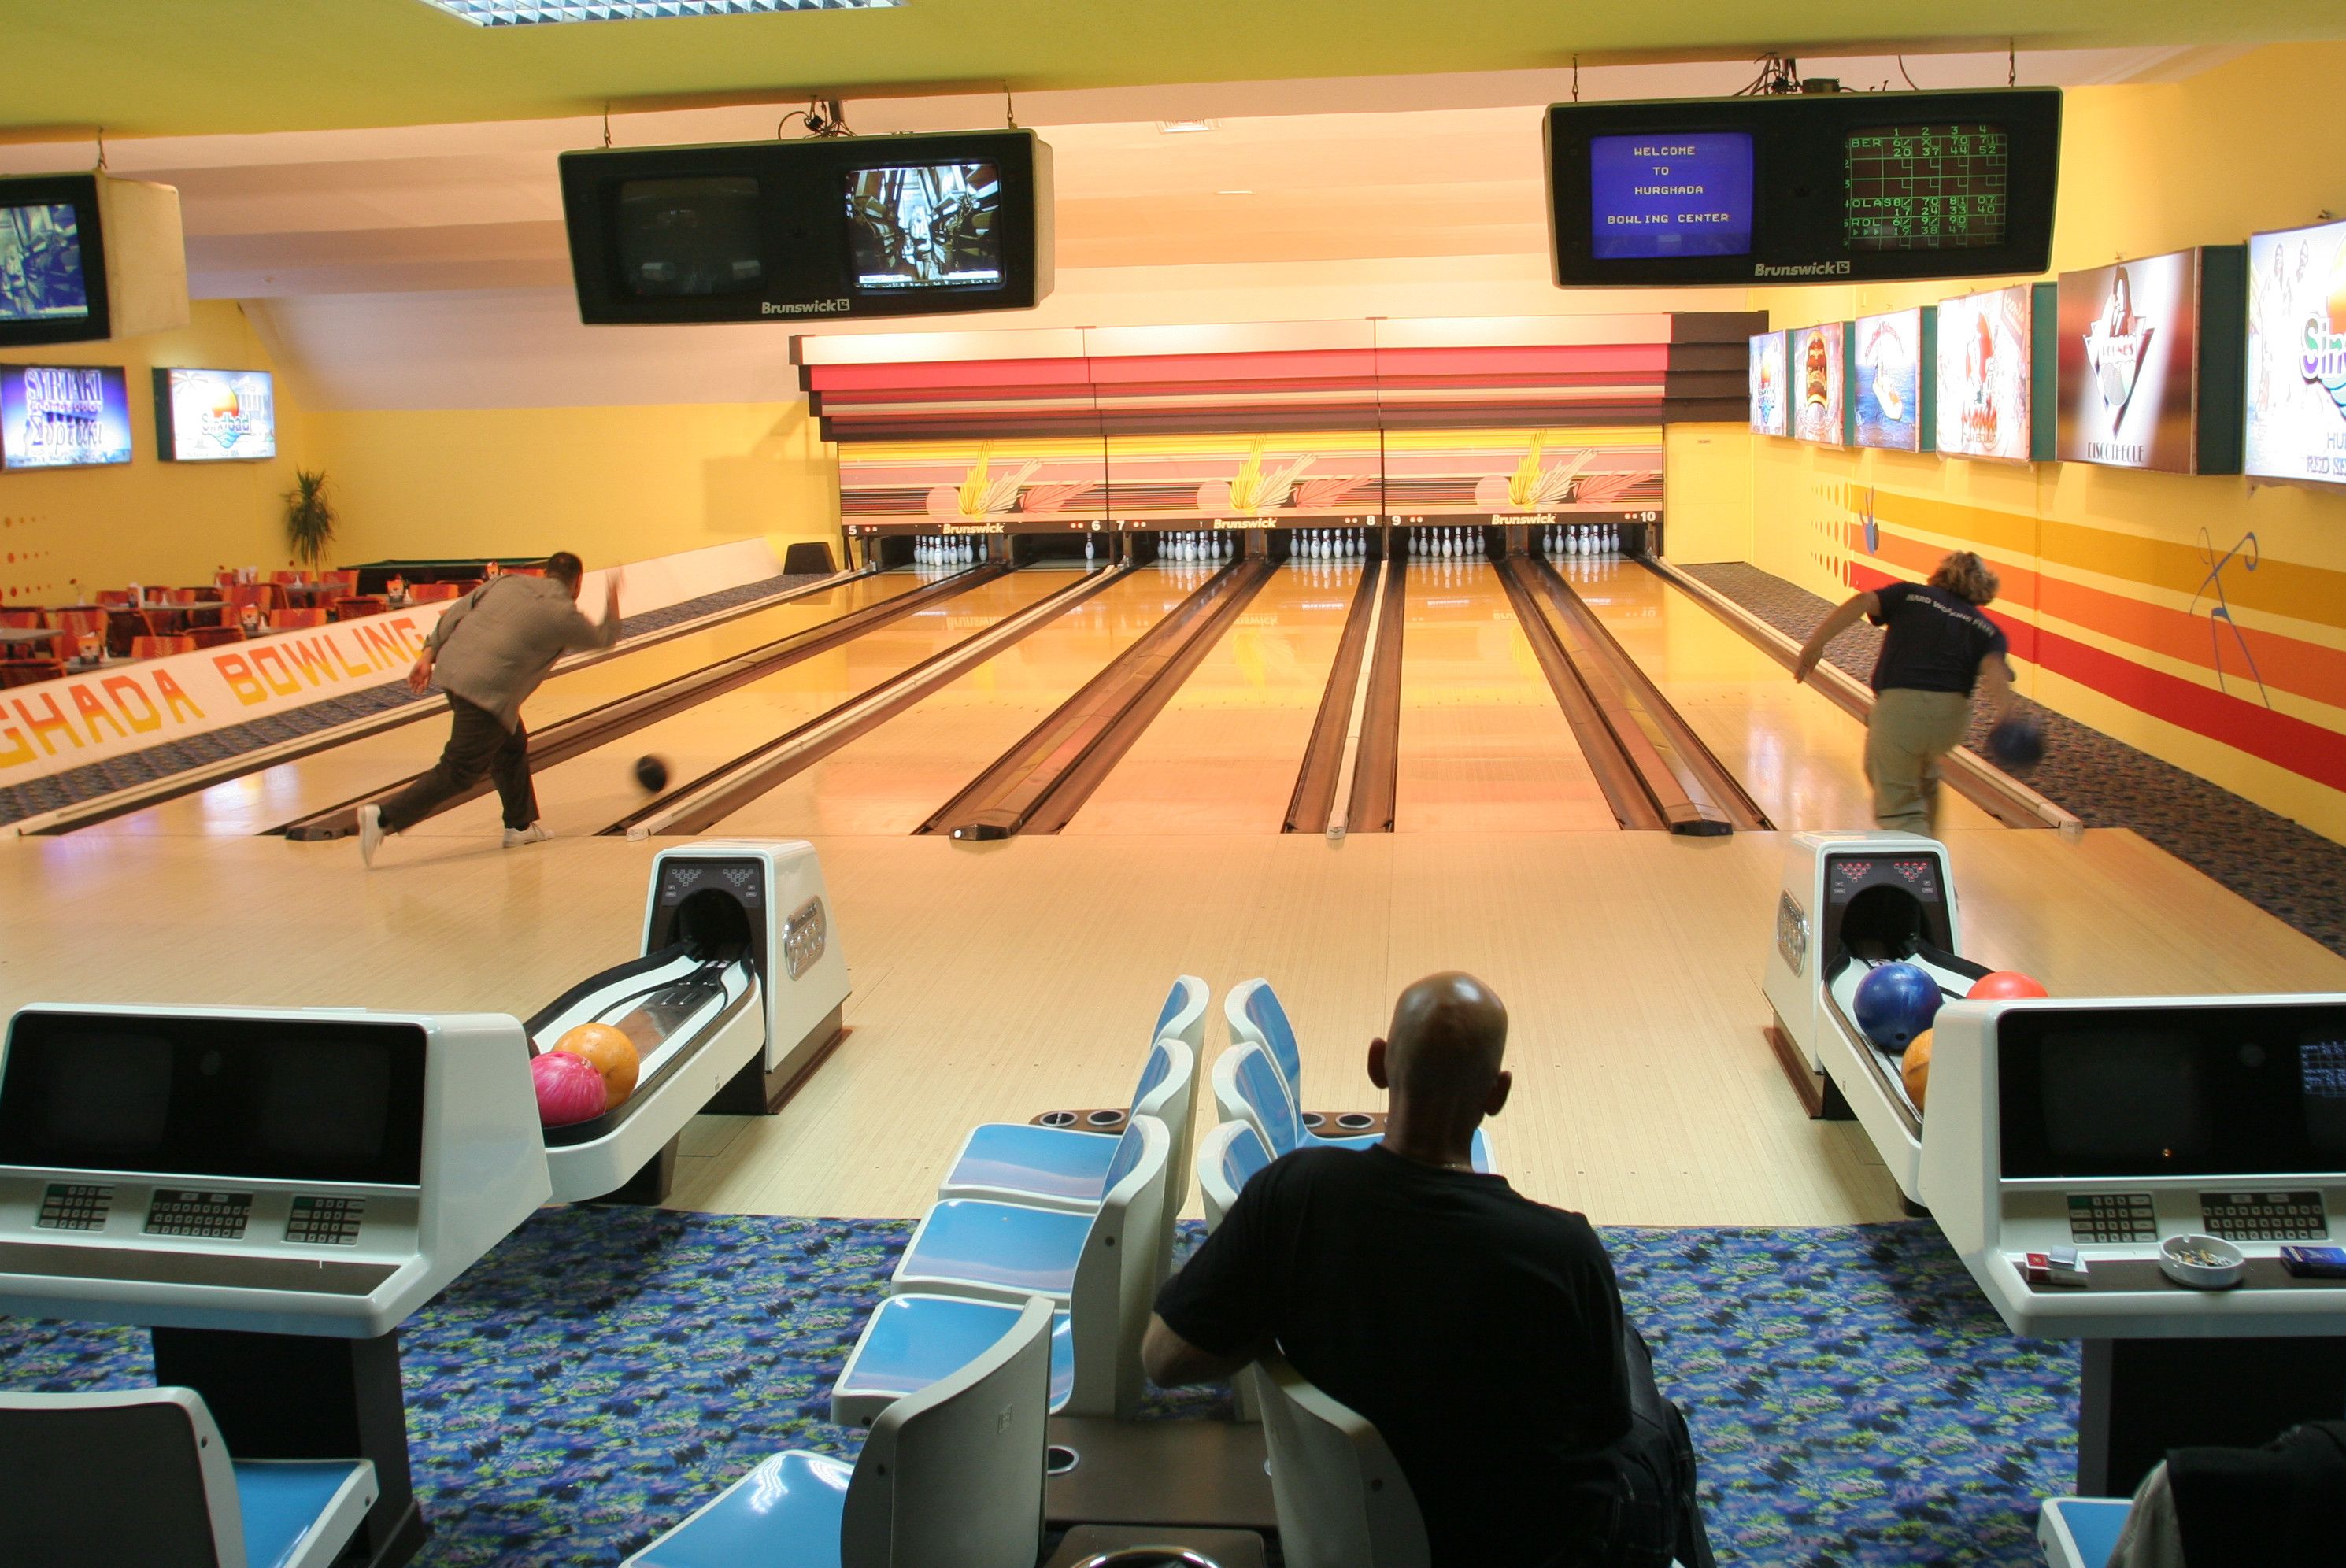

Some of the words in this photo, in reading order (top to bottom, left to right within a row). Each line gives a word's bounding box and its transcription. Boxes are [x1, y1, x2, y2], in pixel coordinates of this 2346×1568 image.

[1951, 126, 1958, 135] 3
[1852, 139, 1882, 148] BER
[1634, 146, 1695, 156] WELCOME
[1893, 148, 1911, 157] 20
[1922, 147, 1940, 156] 37
[1951, 146, 1967, 154] 44
[1979, 146, 1996, 154] 52
[1652, 166, 1669, 176] TO
[1634, 186, 1704, 195] HURGHADA
[1608, 214, 1669, 224] BOWLING
[1678, 213, 1729, 223] CENTER
[1852, 217, 1881, 227] ROL
[1893, 227, 1910, 235] 19
[1921, 226, 1938, 235] 38
[1949, 225, 1966, 234] 47
[1754, 261, 1836, 276] Brunswick
[761, 299, 837, 314] Brunswick
[2303, 317, 2346, 375] Sin
[2327, 432, 2346, 449] HU
[1367, 516, 1375, 525] 8
[1392, 516, 1401, 526] 9
[1492, 513, 1556, 525] Brunswick
[1640, 512, 1656, 522] 10
[943, 523, 1005, 534] Brunswick
[1092, 520, 1101, 531] 6
[1116, 520, 1125, 531] 7
[1214, 518, 1277, 529] Brunswick
[849, 525, 857, 535] 5
[212, 617, 427, 706] BOWLING
